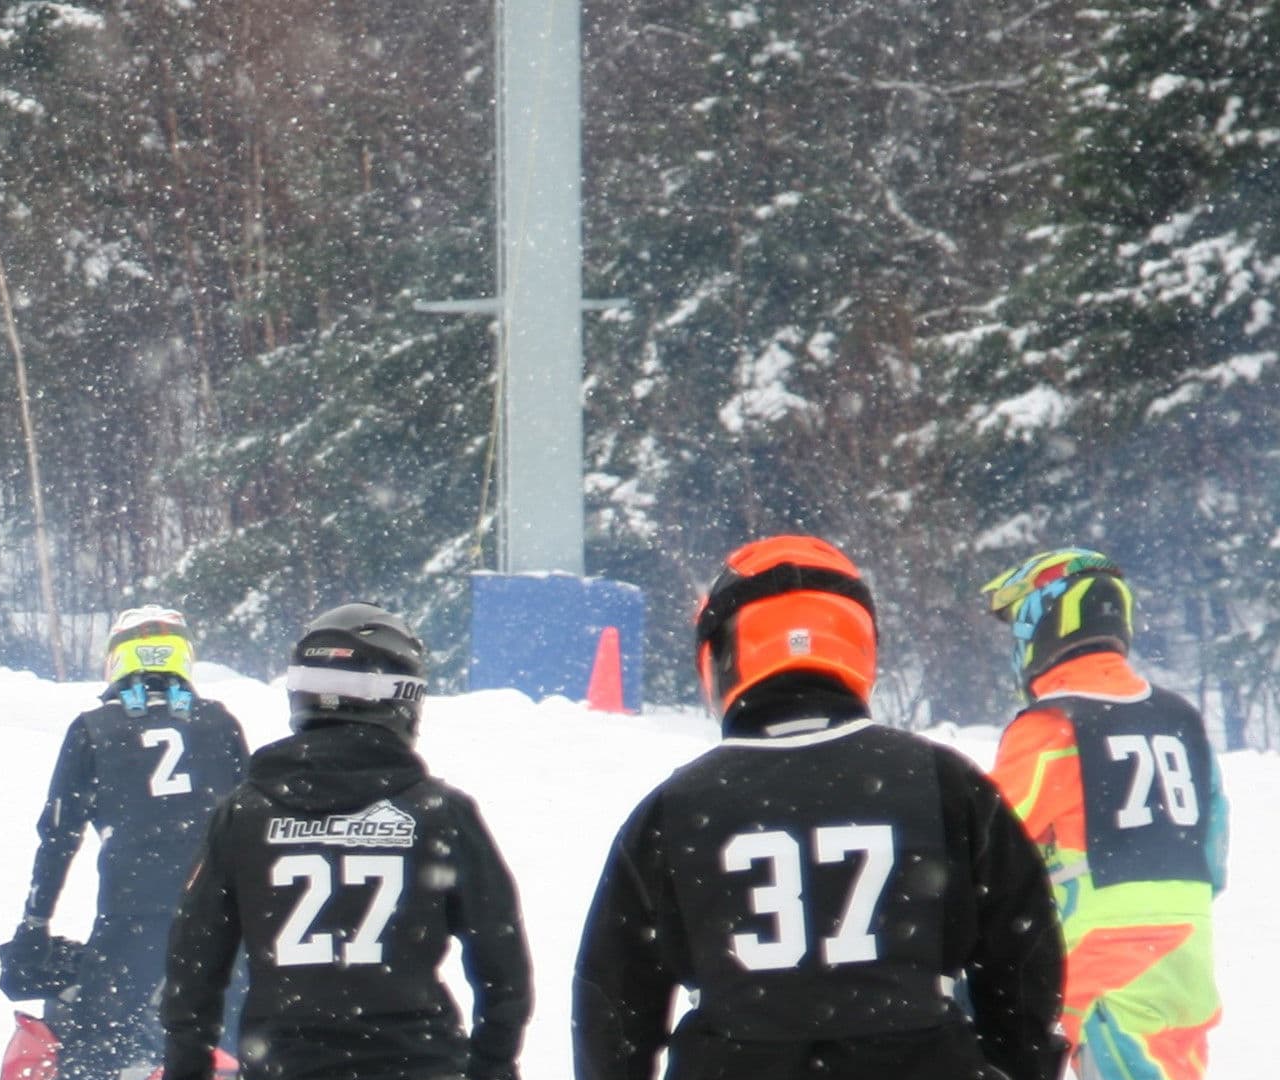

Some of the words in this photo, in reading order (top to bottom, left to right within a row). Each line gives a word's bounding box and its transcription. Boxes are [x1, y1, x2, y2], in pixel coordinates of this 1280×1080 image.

[141, 728, 192, 796] 2
[1107, 735, 1199, 828] 78
[272, 855, 403, 966] 27
[724, 824, 894, 970] 37
